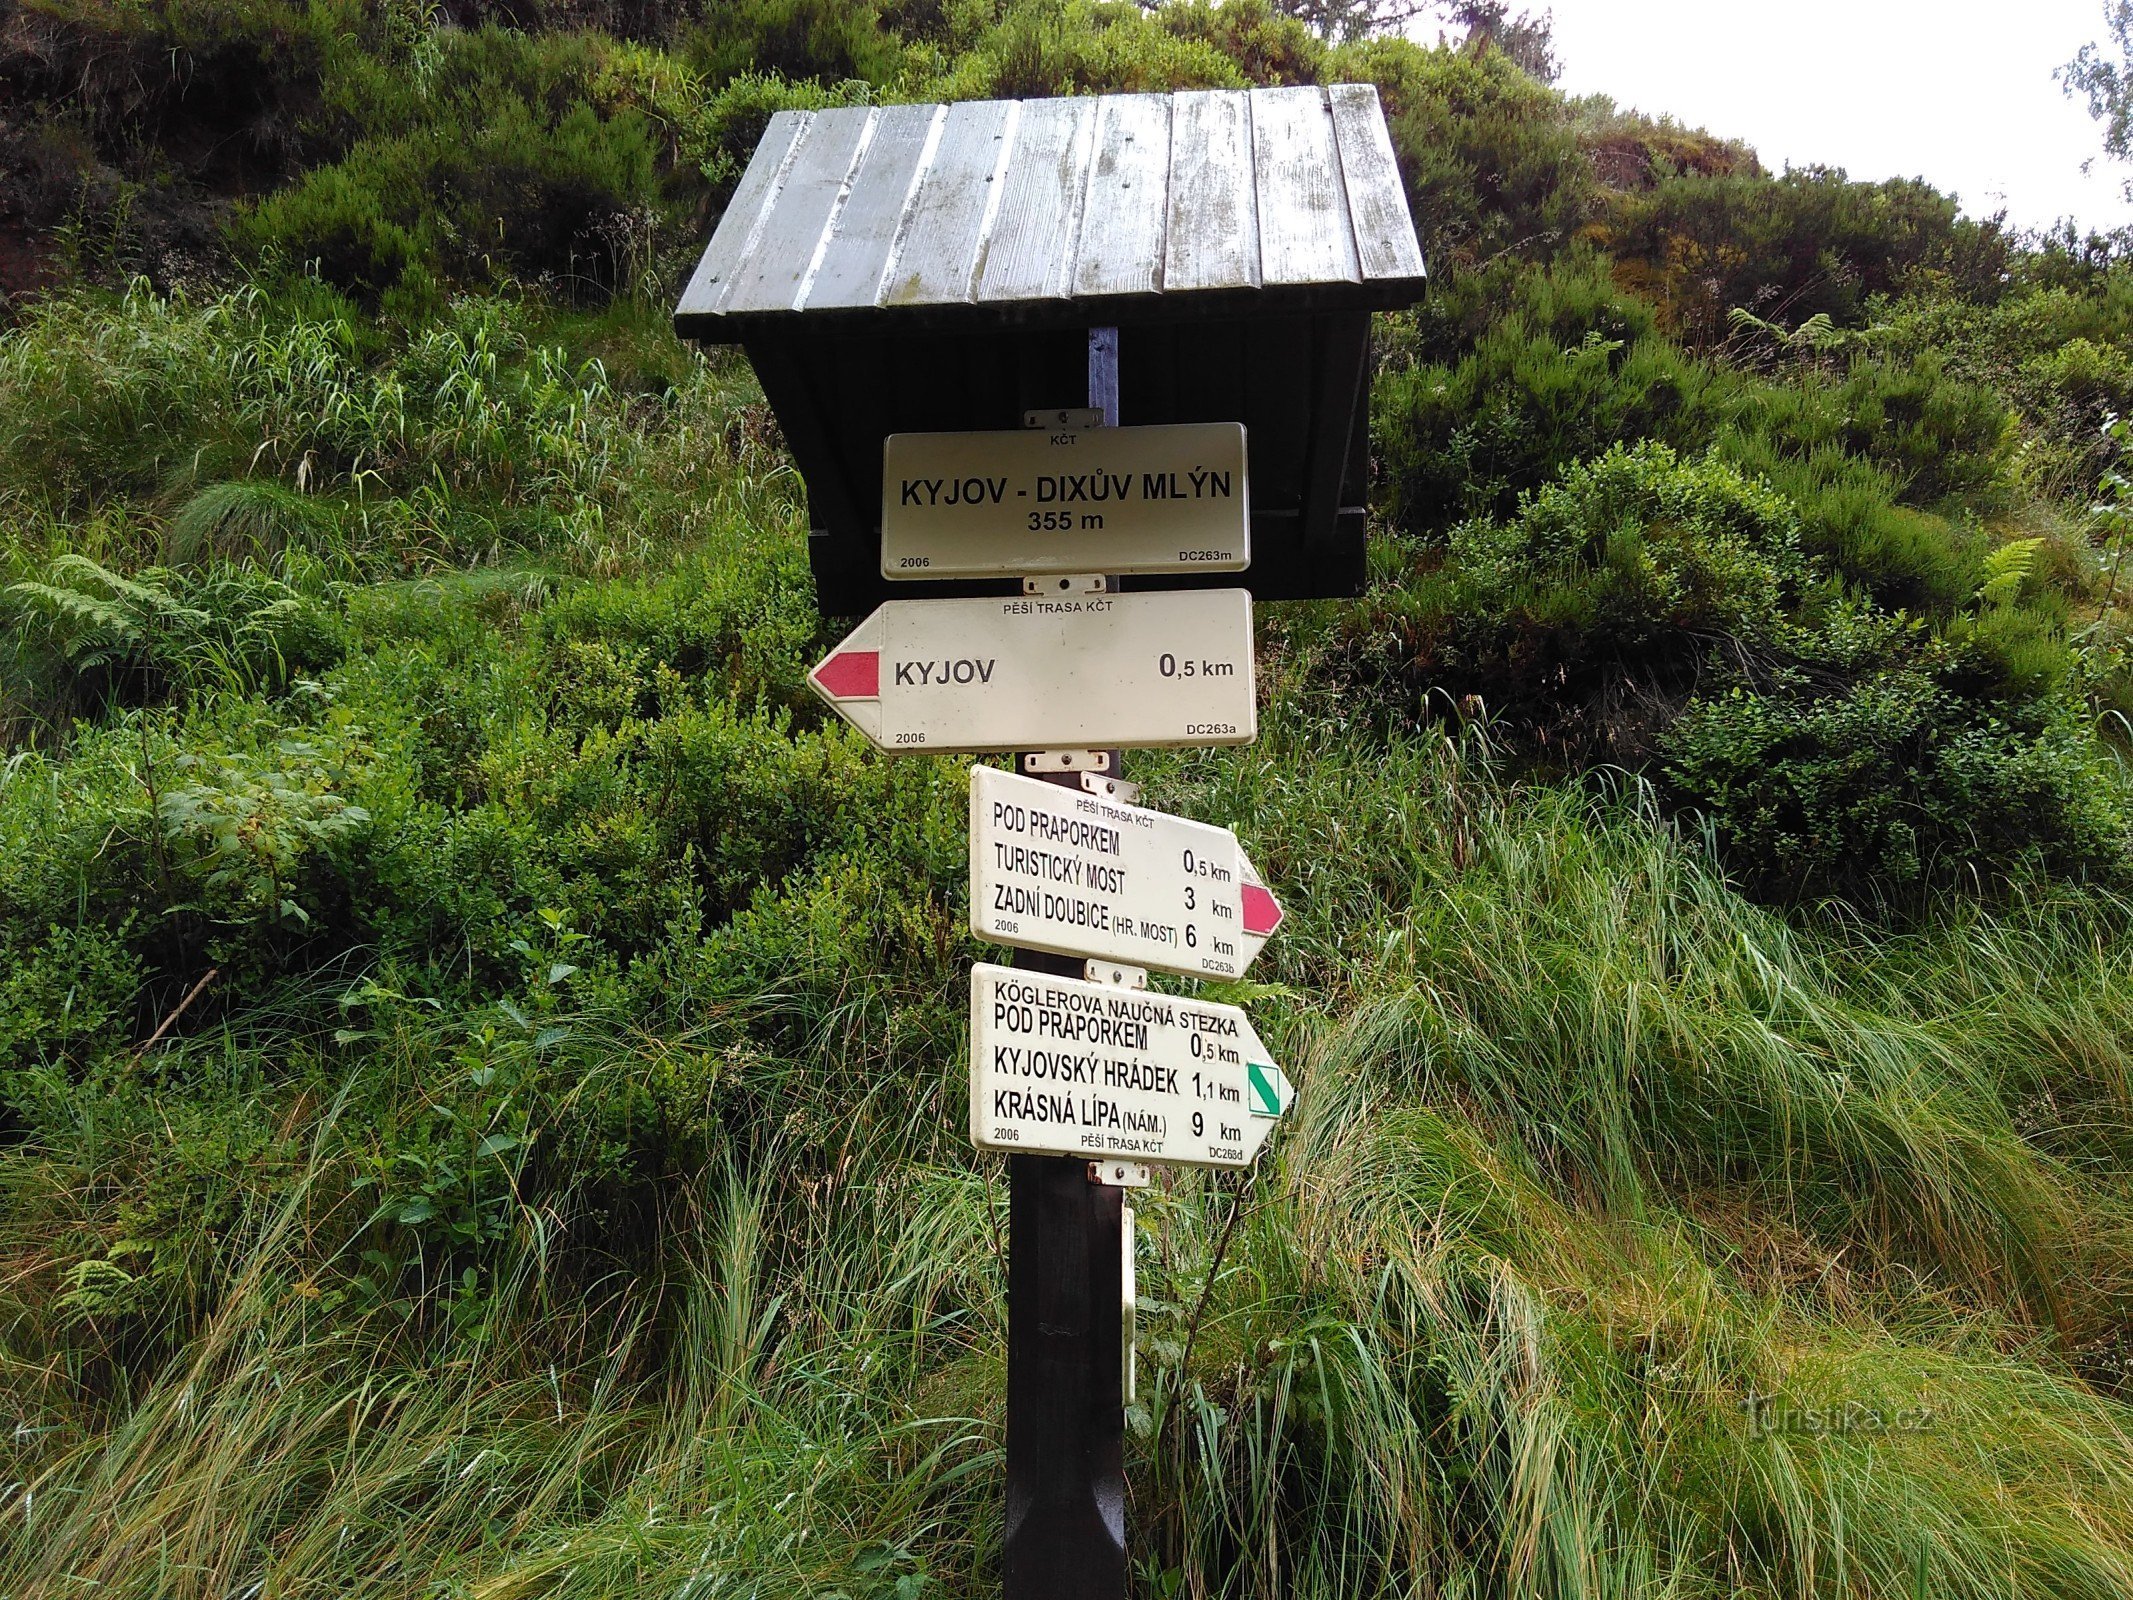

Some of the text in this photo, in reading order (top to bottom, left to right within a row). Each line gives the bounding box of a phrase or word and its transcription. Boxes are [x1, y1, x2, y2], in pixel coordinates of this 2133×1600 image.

[1050, 433, 1077, 445] KČT
[902, 478, 1007, 505] KYJOV
[1037, 468, 1132, 502] DIXŮV
[1143, 466, 1231, 500] MLÝN
[1028, 511, 1103, 530] 355 m
[900, 557, 930, 568] 2006
[1179, 551, 1232, 561] DC263m
[1003, 598, 1113, 614] PĚŠÍ TRASA KČT
[895, 660, 996, 685] KYJOV
[1159, 653, 1233, 680] 0,5 km
[895, 732, 926, 743] 2006
[1186, 724, 1236, 735] DC263a
[1077, 800, 1154, 828] PĚŠÍ TRASA KČT
[994, 802, 1120, 856] POD PRAPORKEM
[995, 842, 1125, 894] TURISTICKÝ MOST
[1184, 850, 1230, 882] 0,5 km
[995, 884, 1178, 948] ZADNÍ DOUBICE (HR. MOST)
[1184, 887, 1232, 919] 3 km
[995, 919, 1018, 933] 2006
[1185, 924, 1233, 956] 6 km
[1202, 958, 1234, 973] DC263b
[996, 980, 1238, 1037] KÖGLEROVA NAUČNÁ STEZKA
[995, 1003, 1148, 1050] POD PRAPORKEM
[1191, 1033, 1239, 1064] 0,5 km
[995, 1046, 1179, 1094] KYJOVSKÝ HRÁDEK
[1192, 1073, 1239, 1102] 1,1 km
[995, 1086, 1166, 1137] KRÁSNÁ LÍPA (NÁM.)
[994, 1128, 1019, 1141] 2006
[1192, 1112, 1241, 1141] 9 km
[1081, 1134, 1163, 1153] PĚŠÍ TRASA KČT
[1209, 1146, 1242, 1161] DC263d
